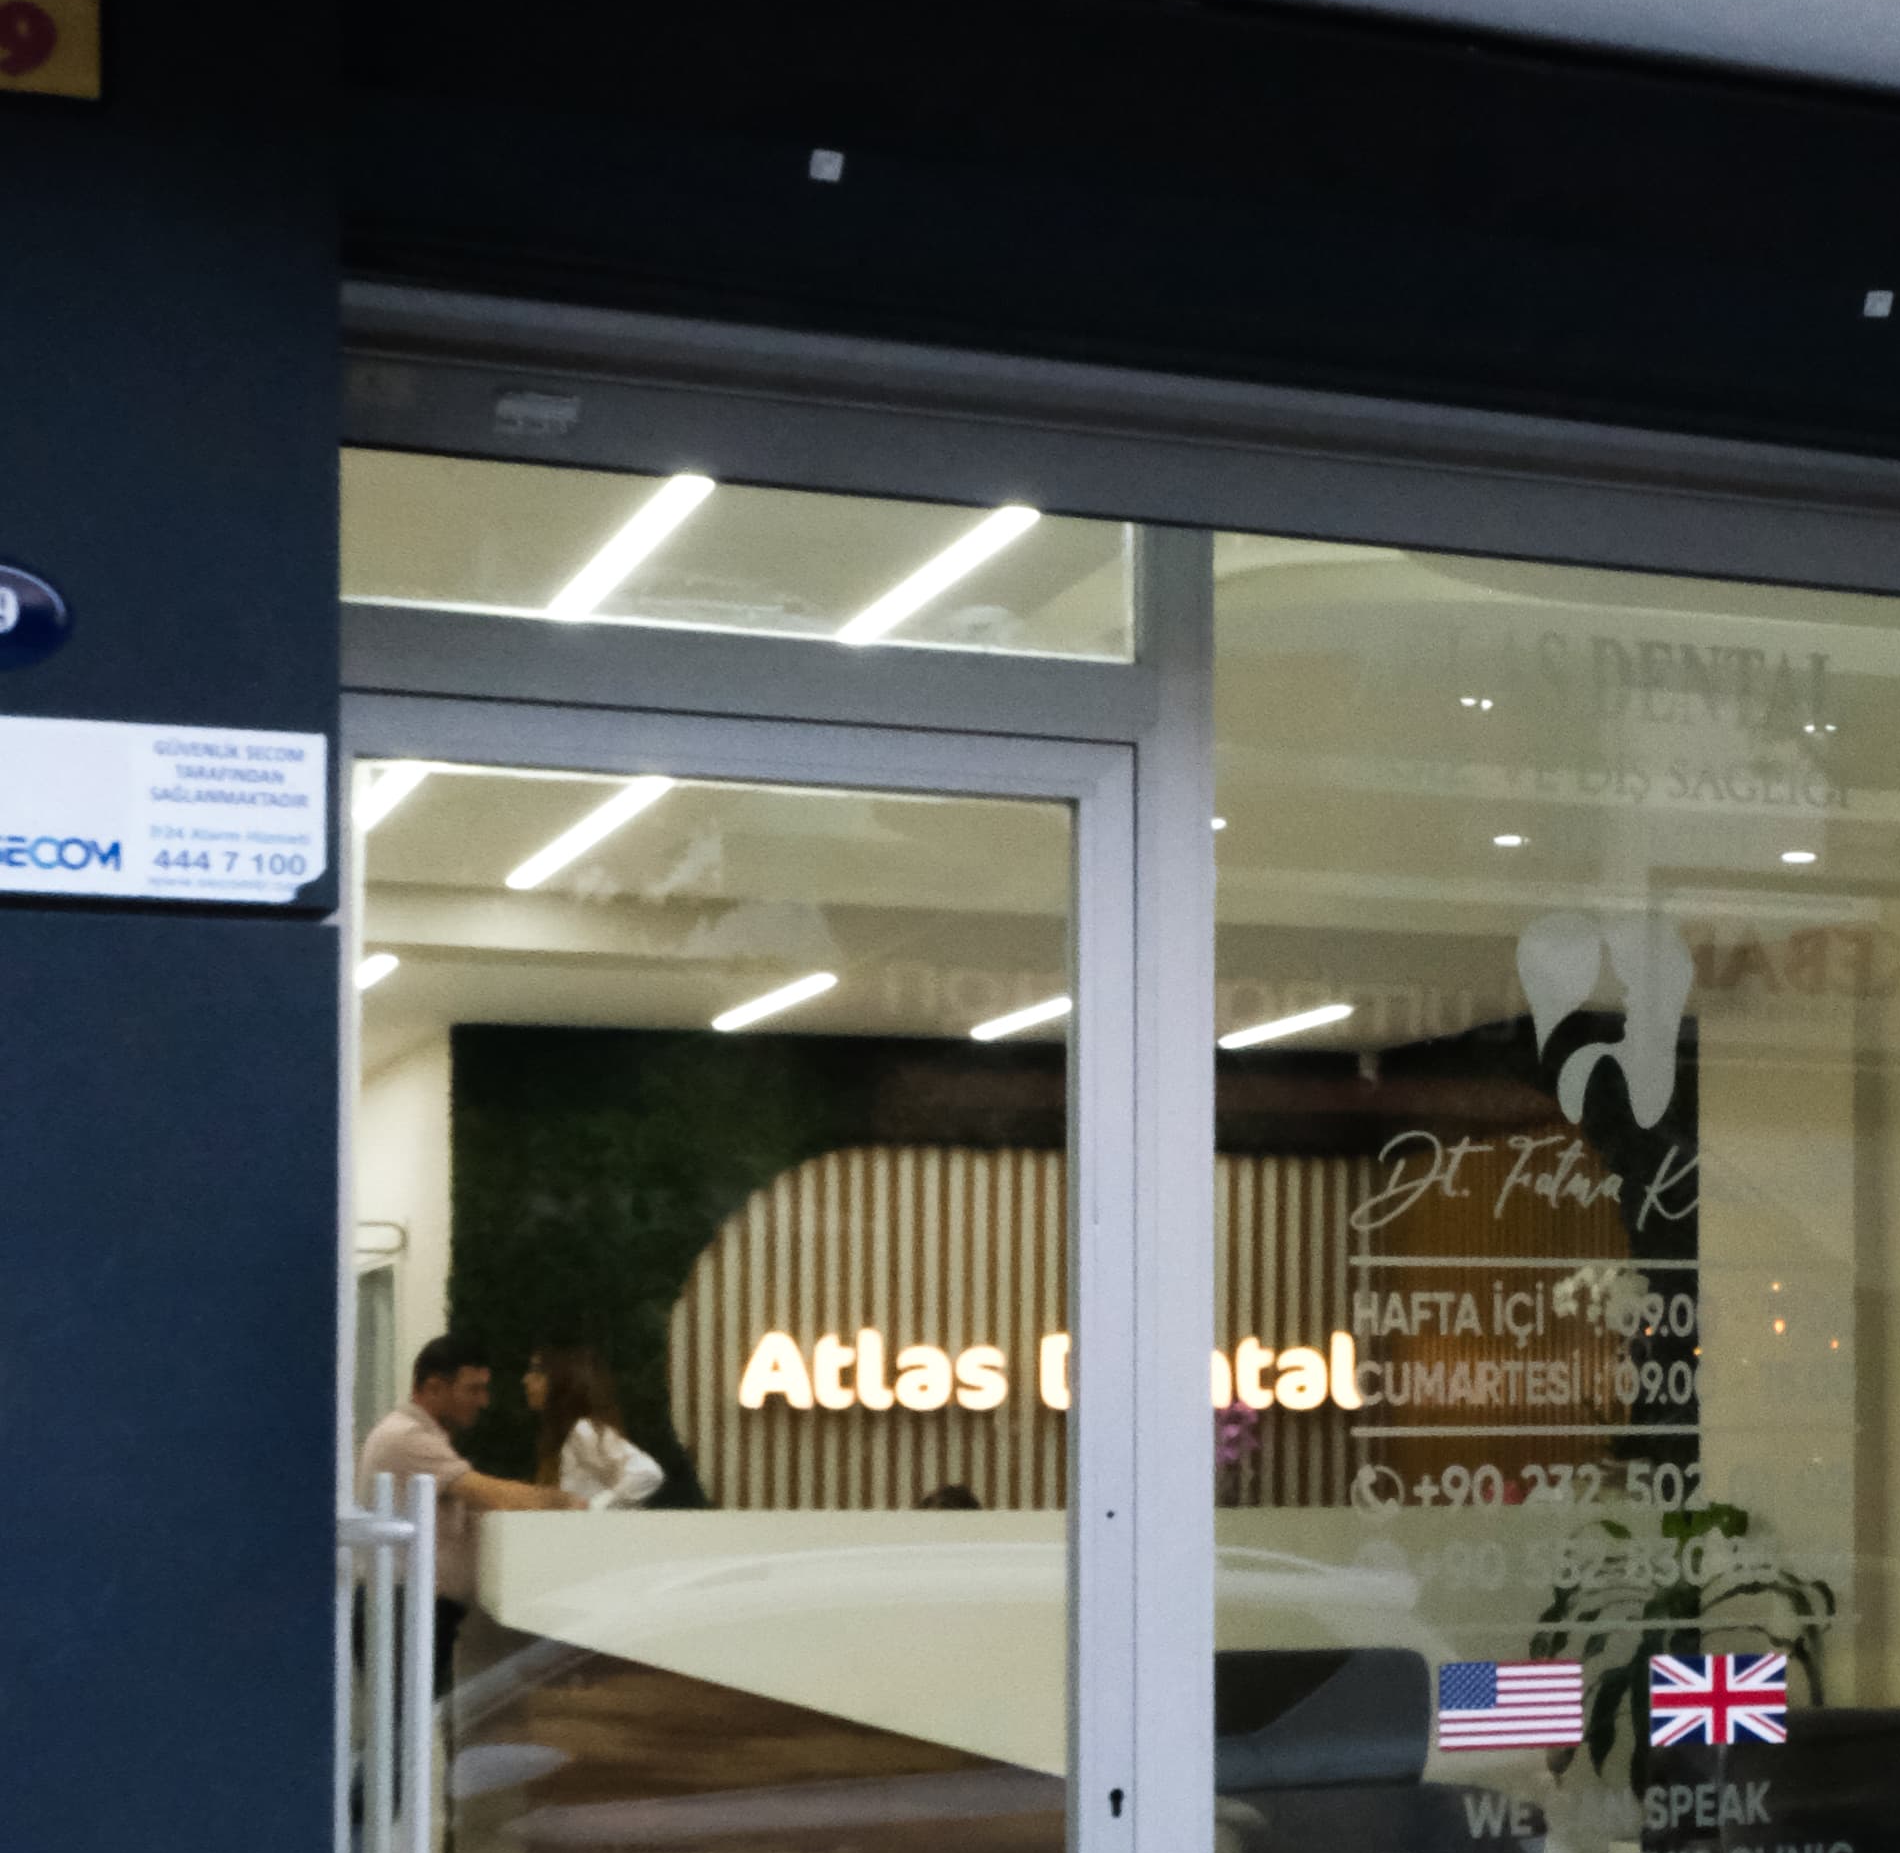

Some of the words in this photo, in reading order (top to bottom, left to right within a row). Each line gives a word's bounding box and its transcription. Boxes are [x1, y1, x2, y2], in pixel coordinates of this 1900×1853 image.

[0, 835, 122, 871] ECOM
[153, 849, 211, 870] 444
[223, 851, 239, 872] 7
[252, 853, 307, 875] 100
[1353, 1292, 1483, 1336] HAFTA
[1493, 1281, 1544, 1347] İÇİ
[738, 1328, 1010, 1411] Atlas
[1357, 1350, 1581, 1406] CUMARTESİ
[1615, 1360, 1698, 1406] 09.0
[1413, 1463, 1504, 1508] +90
[1463, 1792, 1534, 1839] WE
[1642, 1780, 1771, 1831] SPEAK
